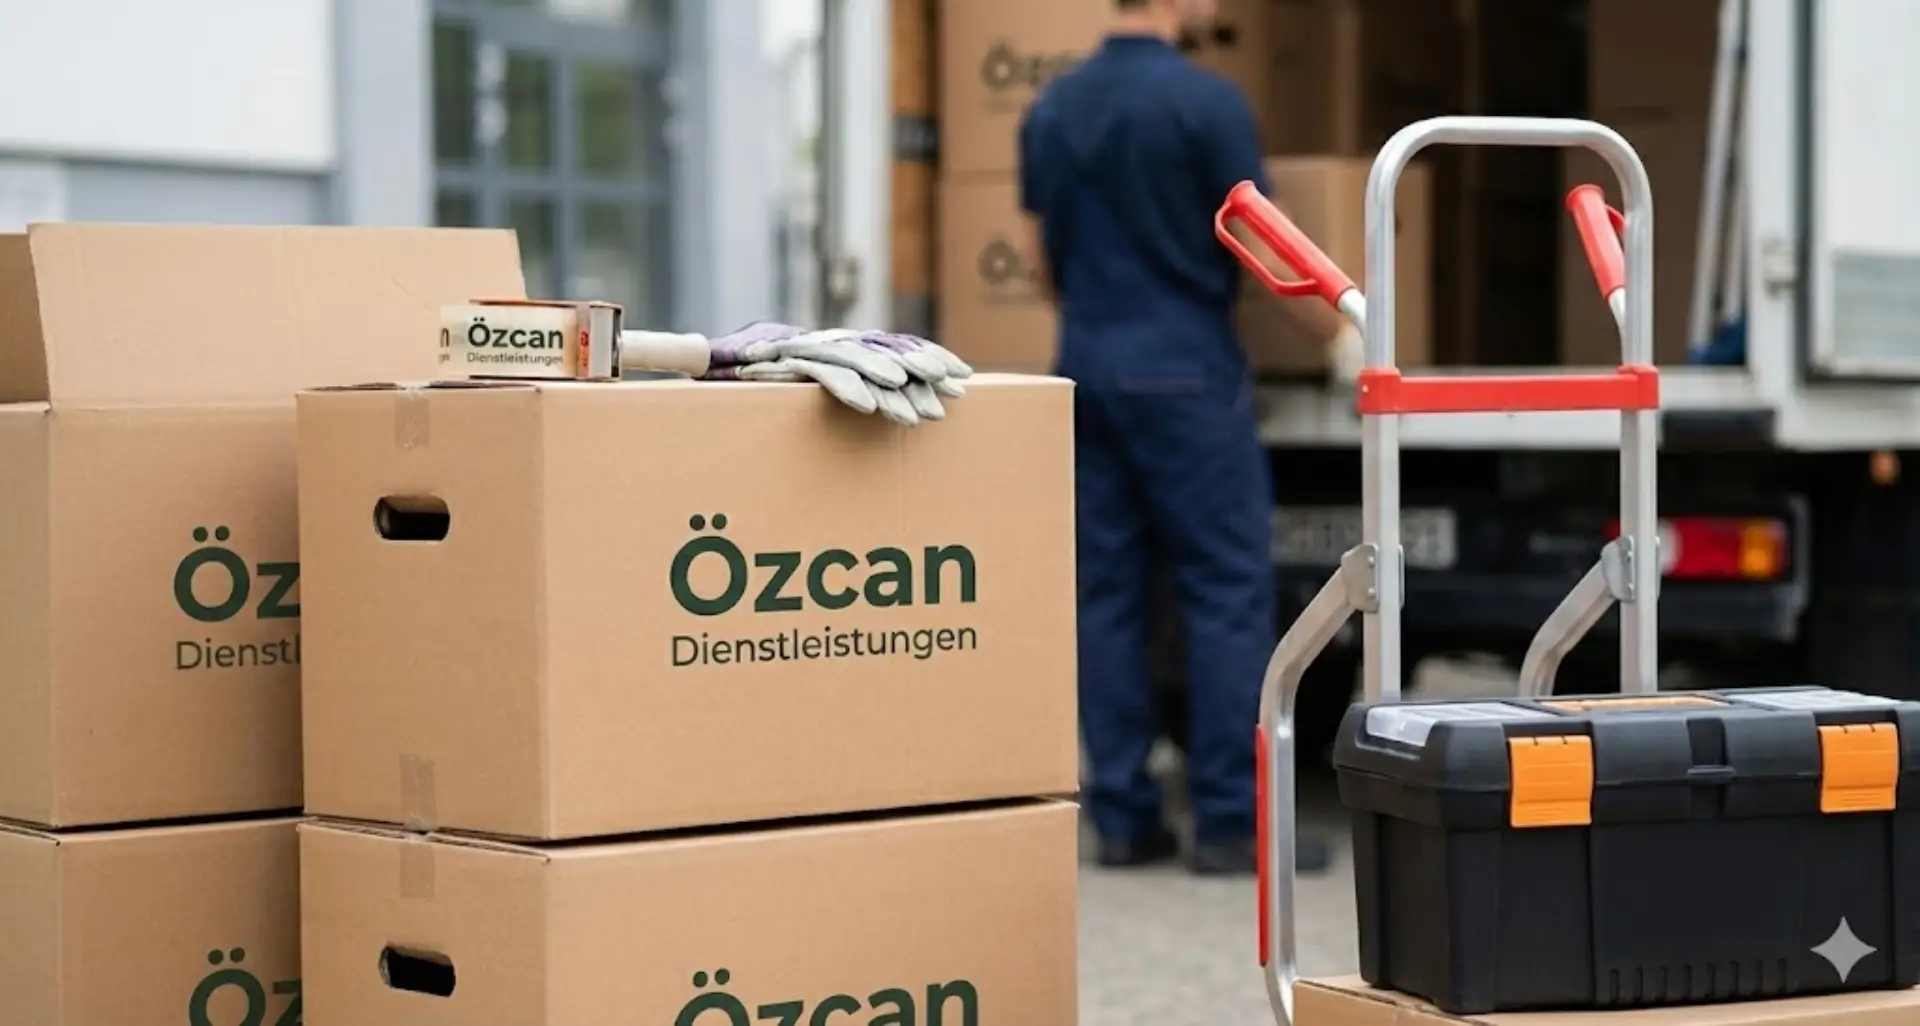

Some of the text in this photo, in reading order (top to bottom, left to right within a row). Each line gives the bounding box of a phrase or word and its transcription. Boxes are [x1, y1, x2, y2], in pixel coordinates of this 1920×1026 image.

[467, 316, 564, 349] Özcan
[670, 513, 977, 617] Özcan
[671, 626, 977, 667] Dienstleistungen
